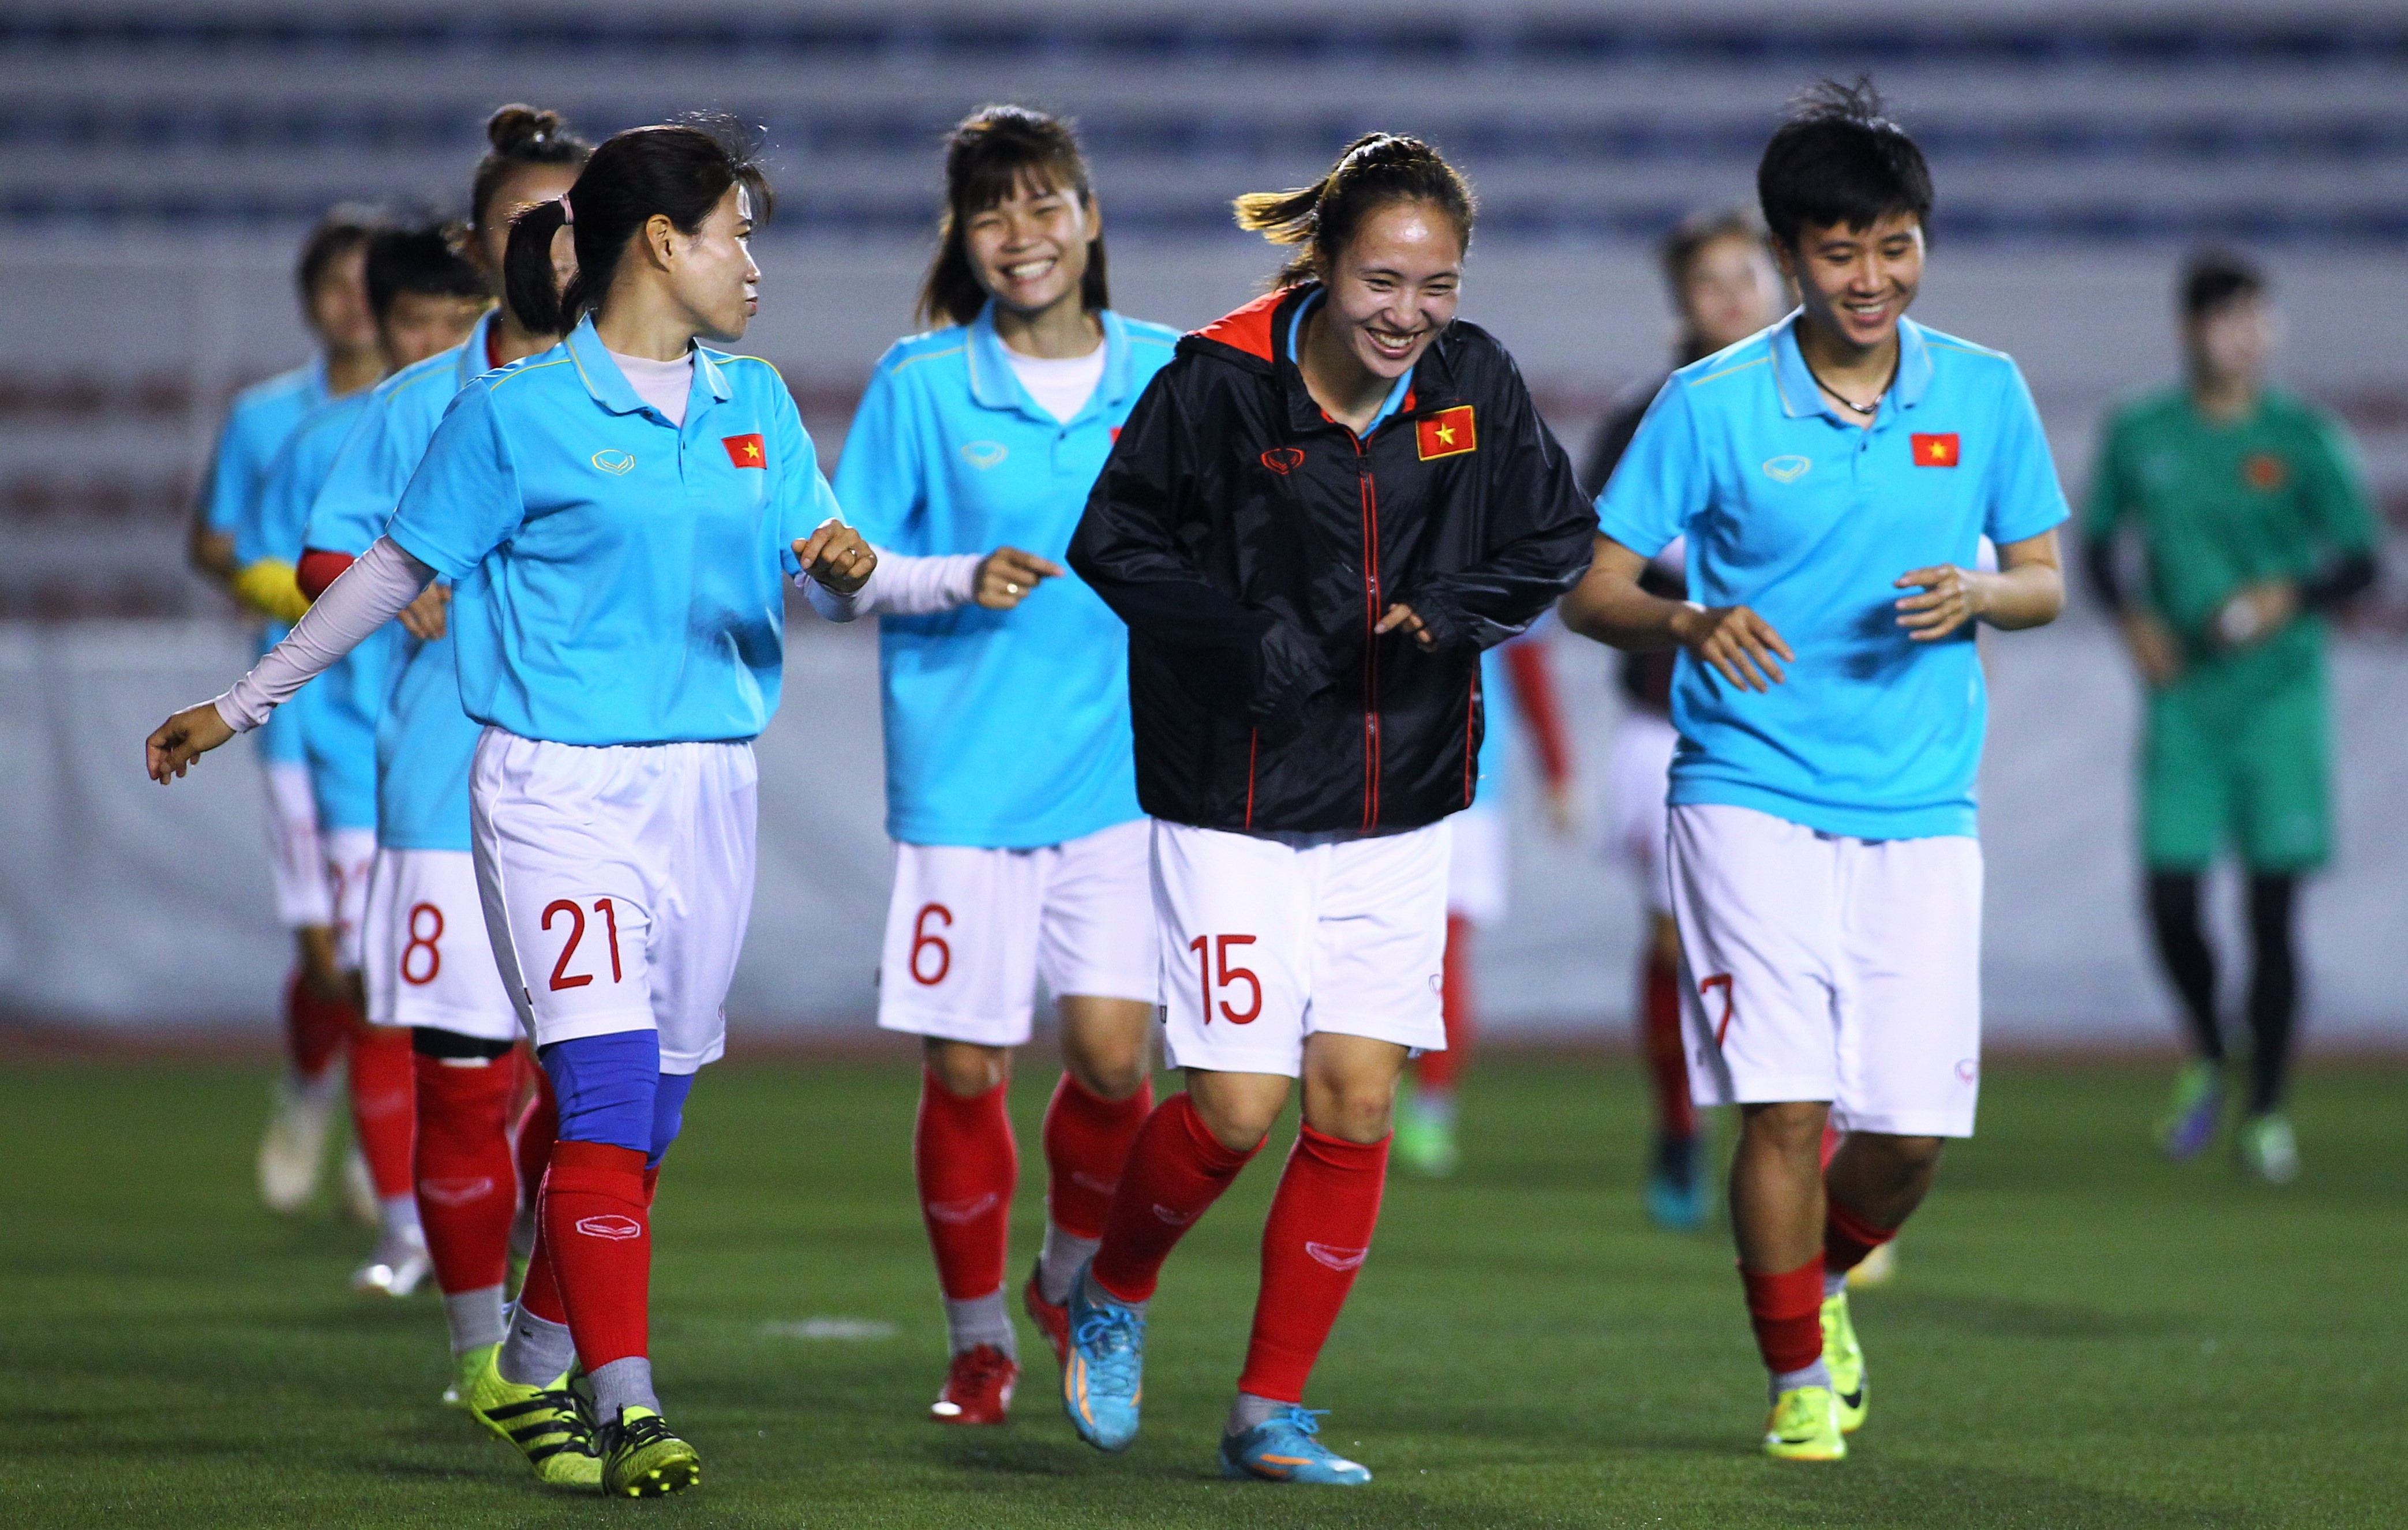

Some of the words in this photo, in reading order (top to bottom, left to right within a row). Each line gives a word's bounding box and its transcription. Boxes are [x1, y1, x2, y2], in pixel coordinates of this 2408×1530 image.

[400, 903, 444, 986] 8
[541, 898, 621, 991] 21
[909, 903, 953, 986] 6
[1190, 933, 1262, 1025] 15
[1700, 973, 1733, 1046] 7
